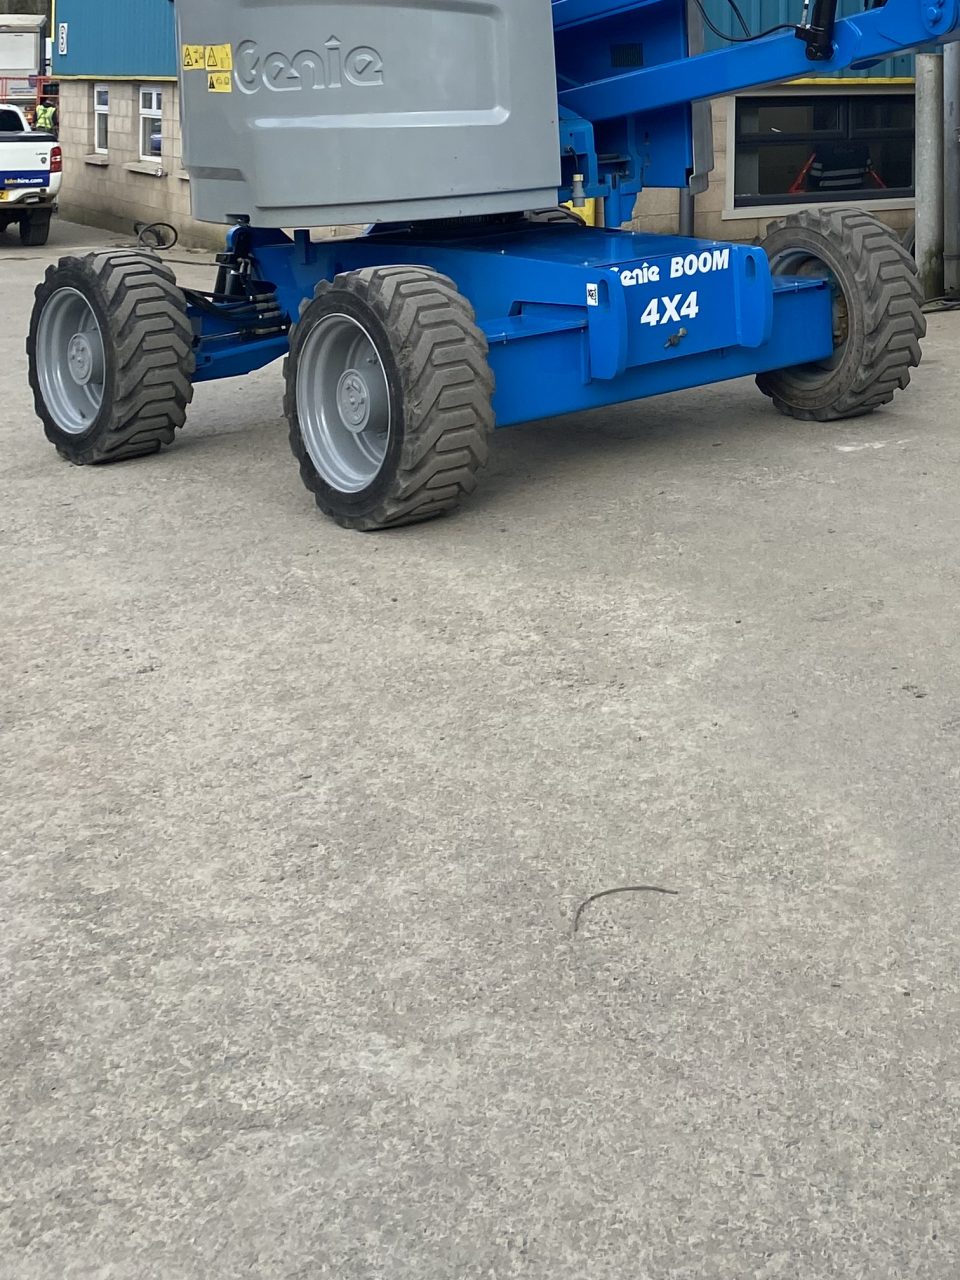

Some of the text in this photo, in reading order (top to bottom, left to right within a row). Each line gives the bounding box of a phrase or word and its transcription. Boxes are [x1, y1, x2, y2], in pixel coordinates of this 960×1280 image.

[234, 34, 384, 95] Genie
[610, 248, 730, 287] enie BOOM
[640, 291, 699, 326] 4X4
